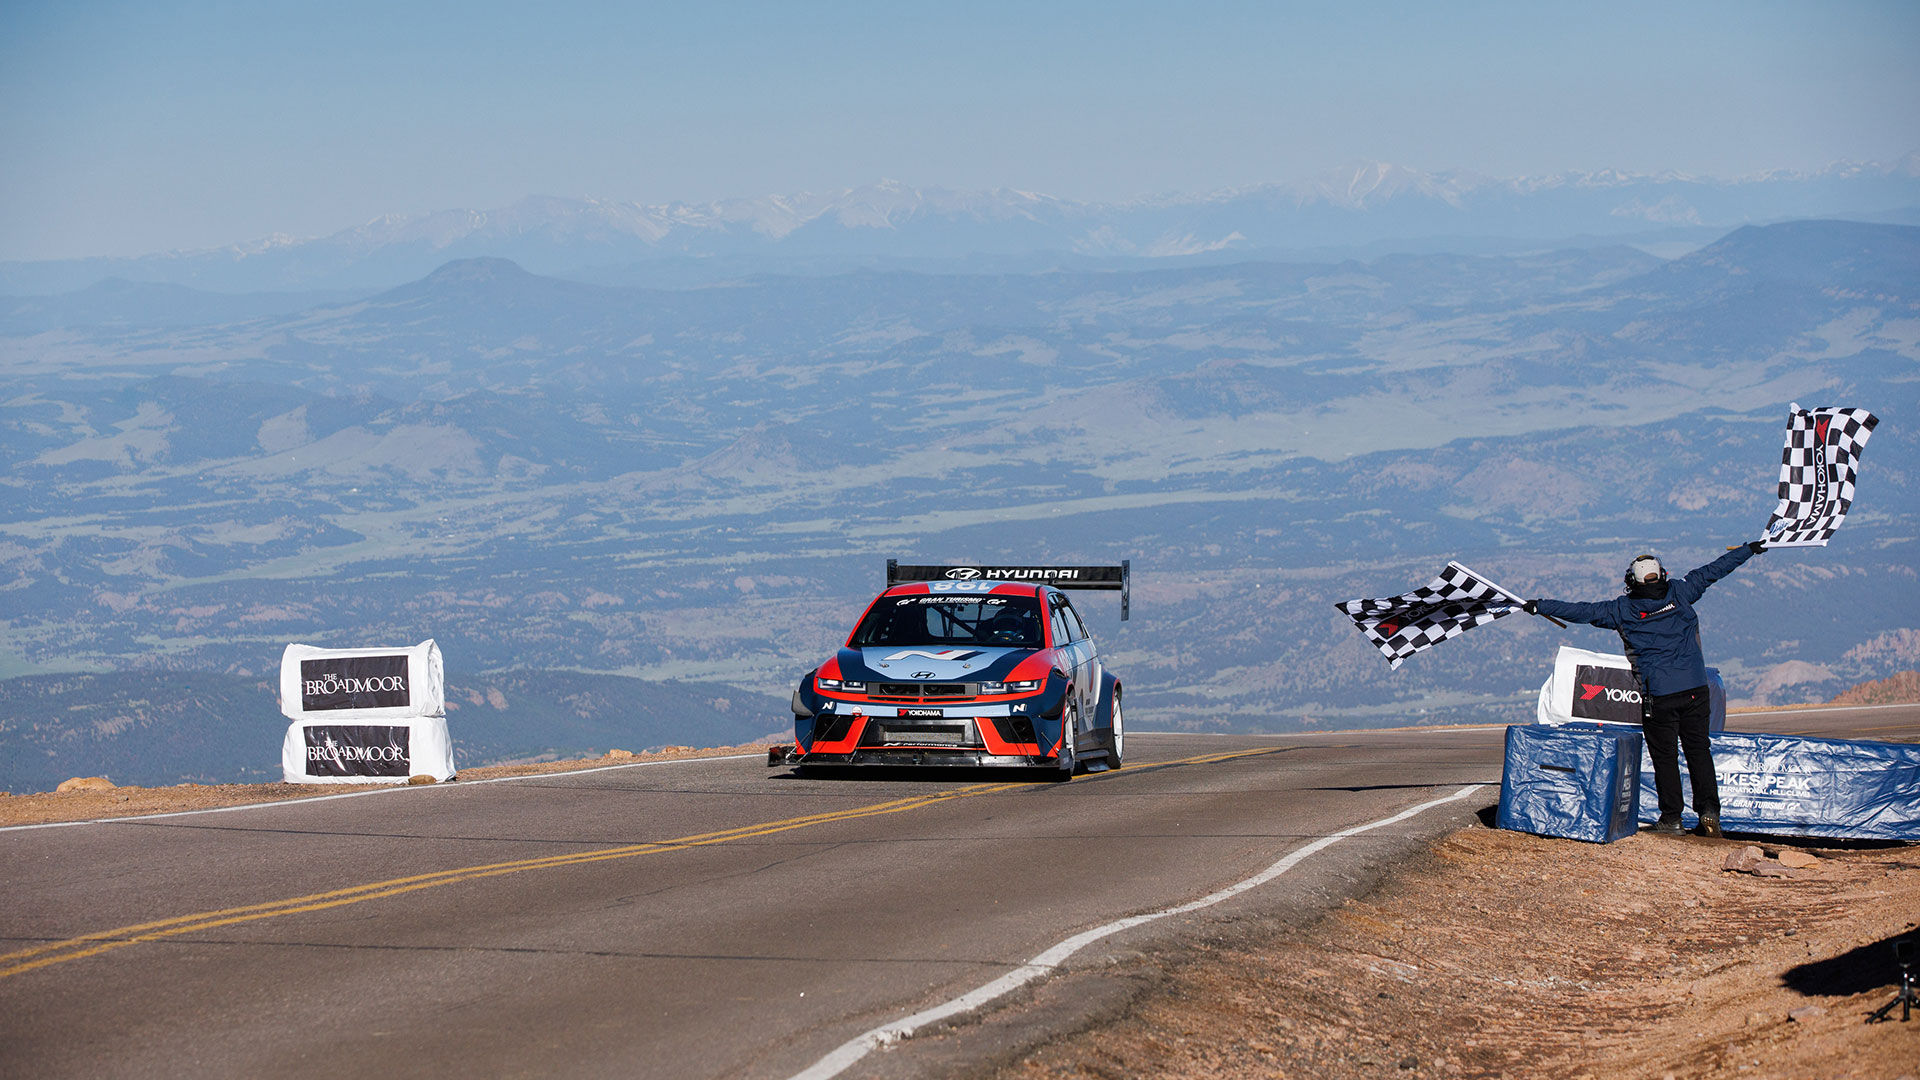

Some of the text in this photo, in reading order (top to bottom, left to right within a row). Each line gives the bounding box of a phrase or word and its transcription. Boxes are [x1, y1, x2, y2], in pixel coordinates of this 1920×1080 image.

[1806, 444, 1826, 526] YOKOHAMA
[986, 569, 1079, 579] HYUNDAI
[323, 673, 338, 681] THE
[305, 676, 405, 695] BROADMOOR
[1604, 687, 1643, 704] YOKO
[307, 746, 406, 761] BROADMOOR
[1716, 772, 1811, 790] PIKES PEAK
[1718, 785, 1768, 795] TERNATIONAL
[1733, 800, 1753, 808] GRAN
[1754, 801, 1786, 810] TURISMO
